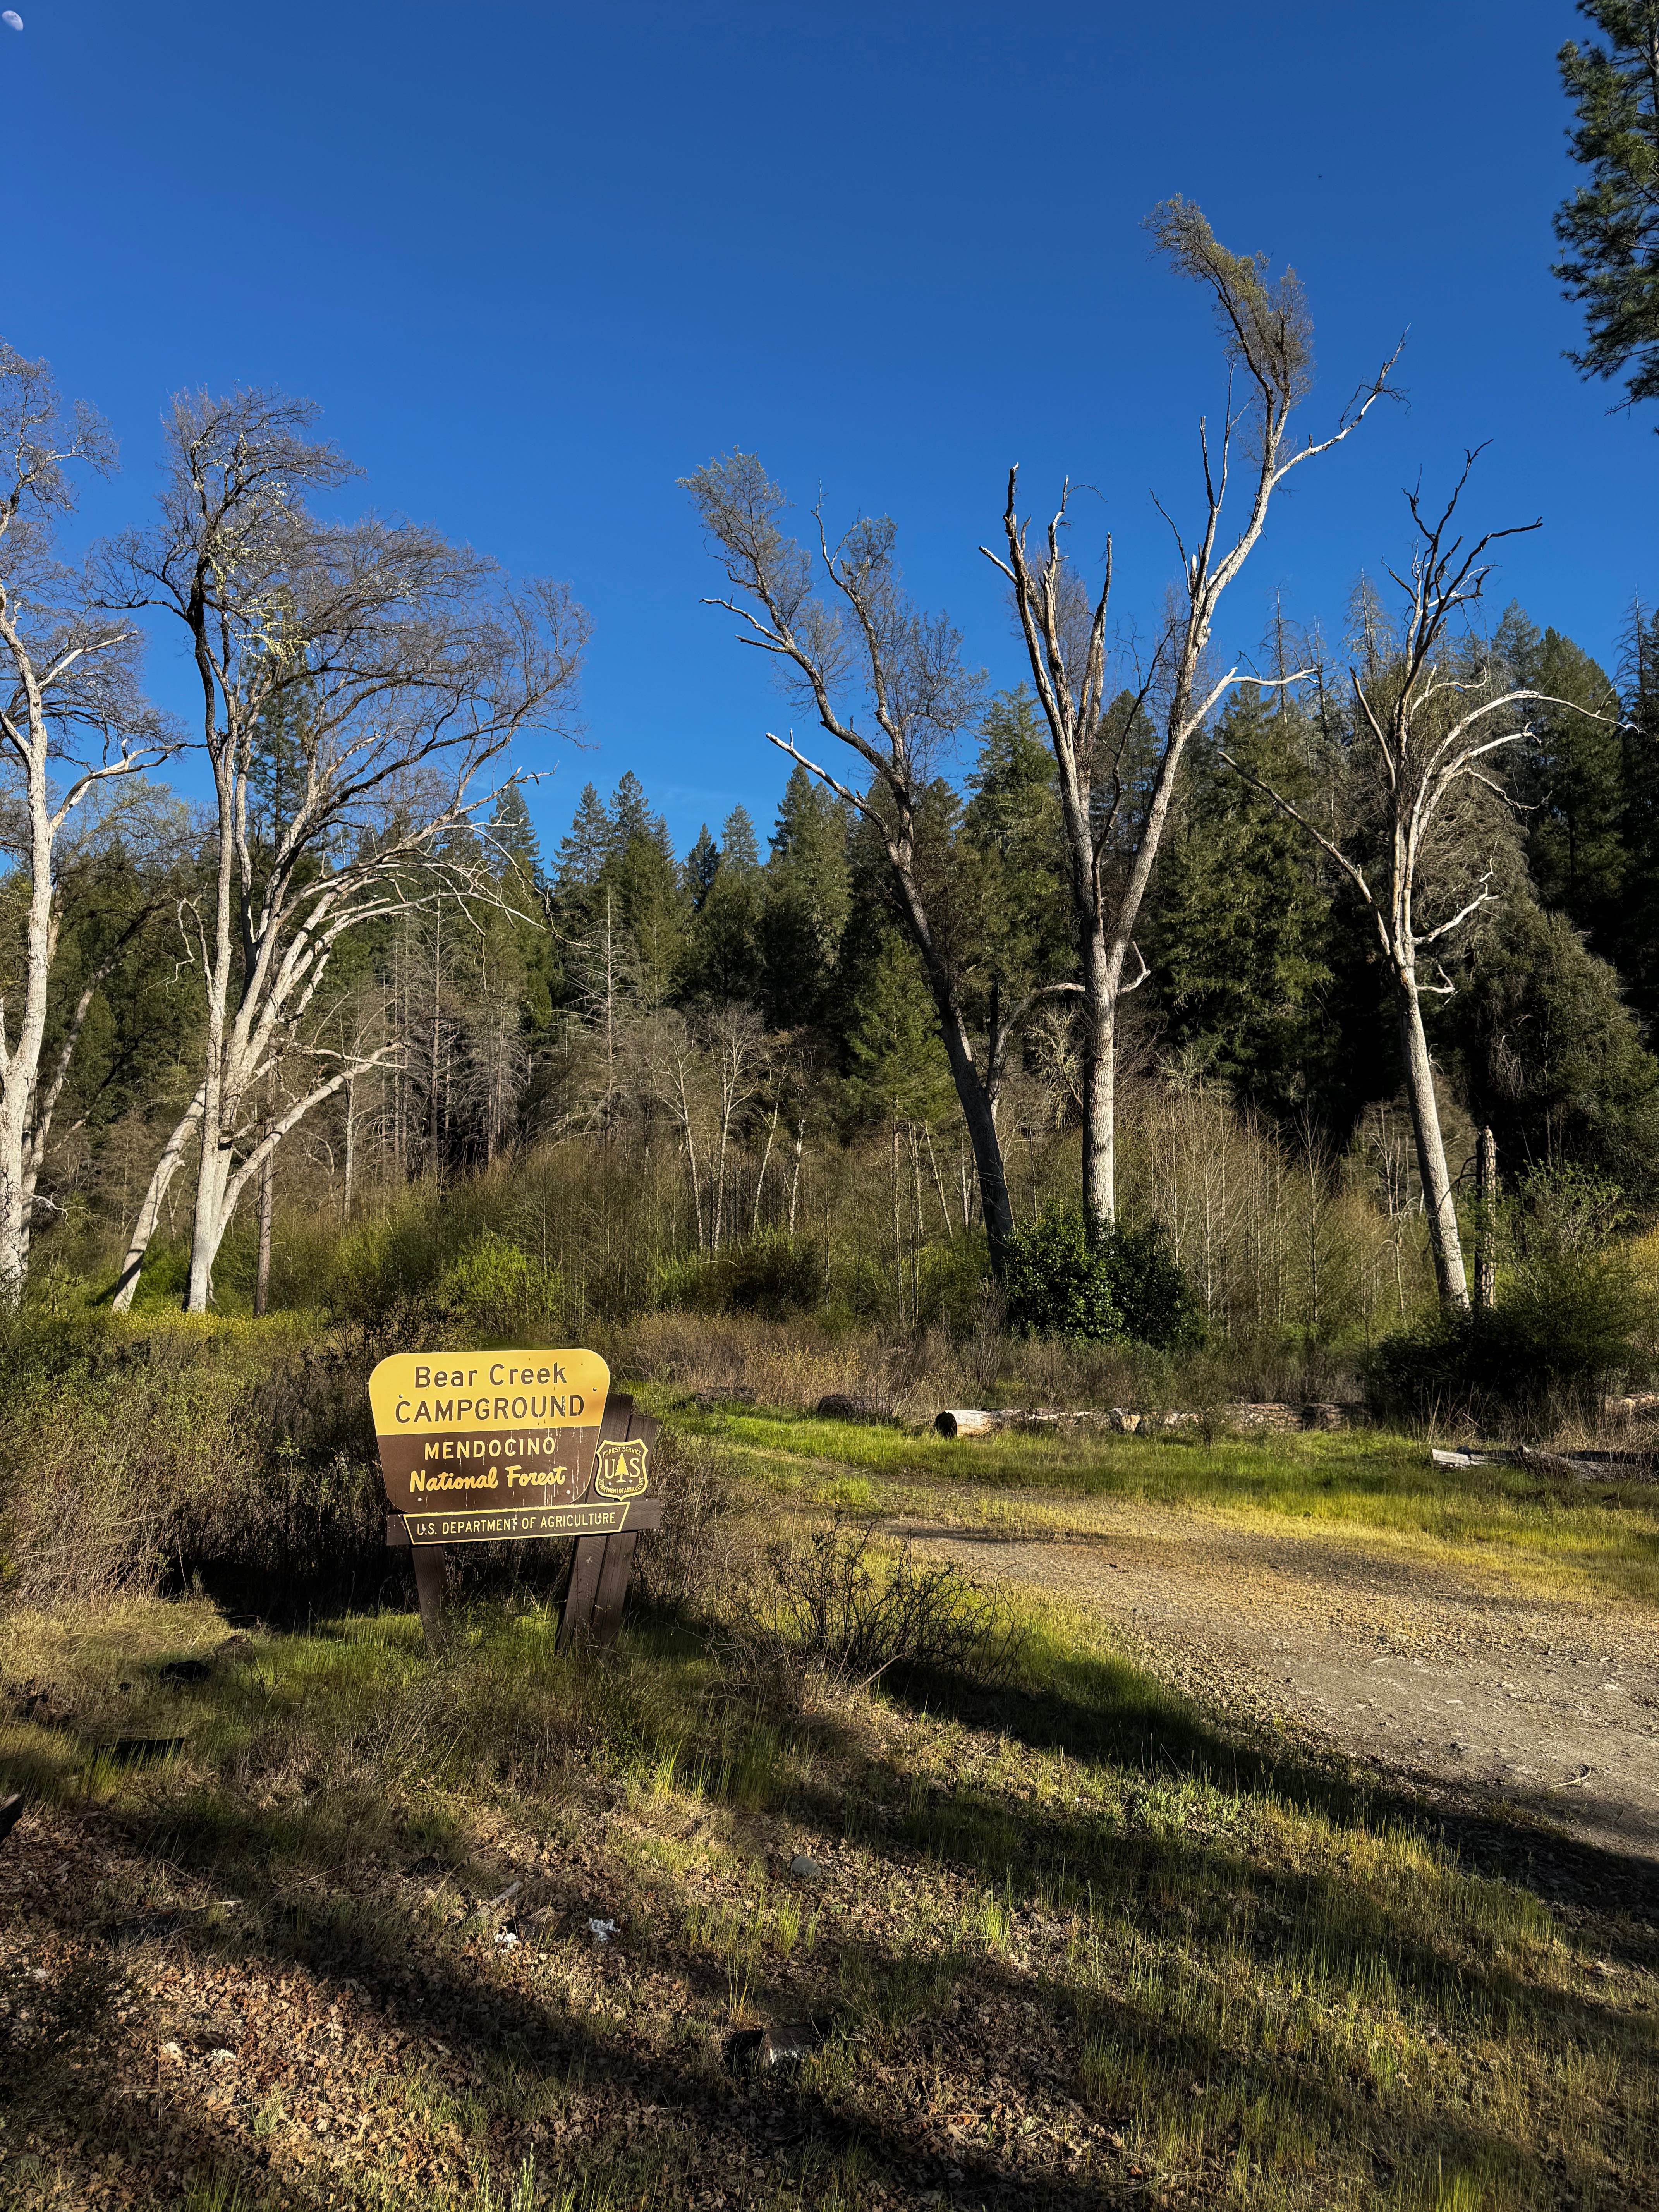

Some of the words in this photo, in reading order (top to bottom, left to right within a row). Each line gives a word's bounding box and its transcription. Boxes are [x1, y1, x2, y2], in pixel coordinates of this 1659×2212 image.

[415, 1366, 477, 1388] Bear
[489, 1362, 567, 1385] Creek
[395, 1395, 584, 1424] CAMPGROUND
[424, 1437, 556, 1460] MENDOCINO
[603, 1447, 621, 1458] FOREST
[622, 1446, 641, 1456] SERVICE
[409, 1466, 498, 1493] National
[507, 1465, 567, 1487] Forest
[599, 1478, 618, 1494] DEPARTMENT
[417, 1523, 437, 1535] U.S.
[442, 1518, 518, 1534] DEPARTMENT
[522, 1517, 535, 1529] OF
[540, 1512, 616, 1528] AGRICULTURE
